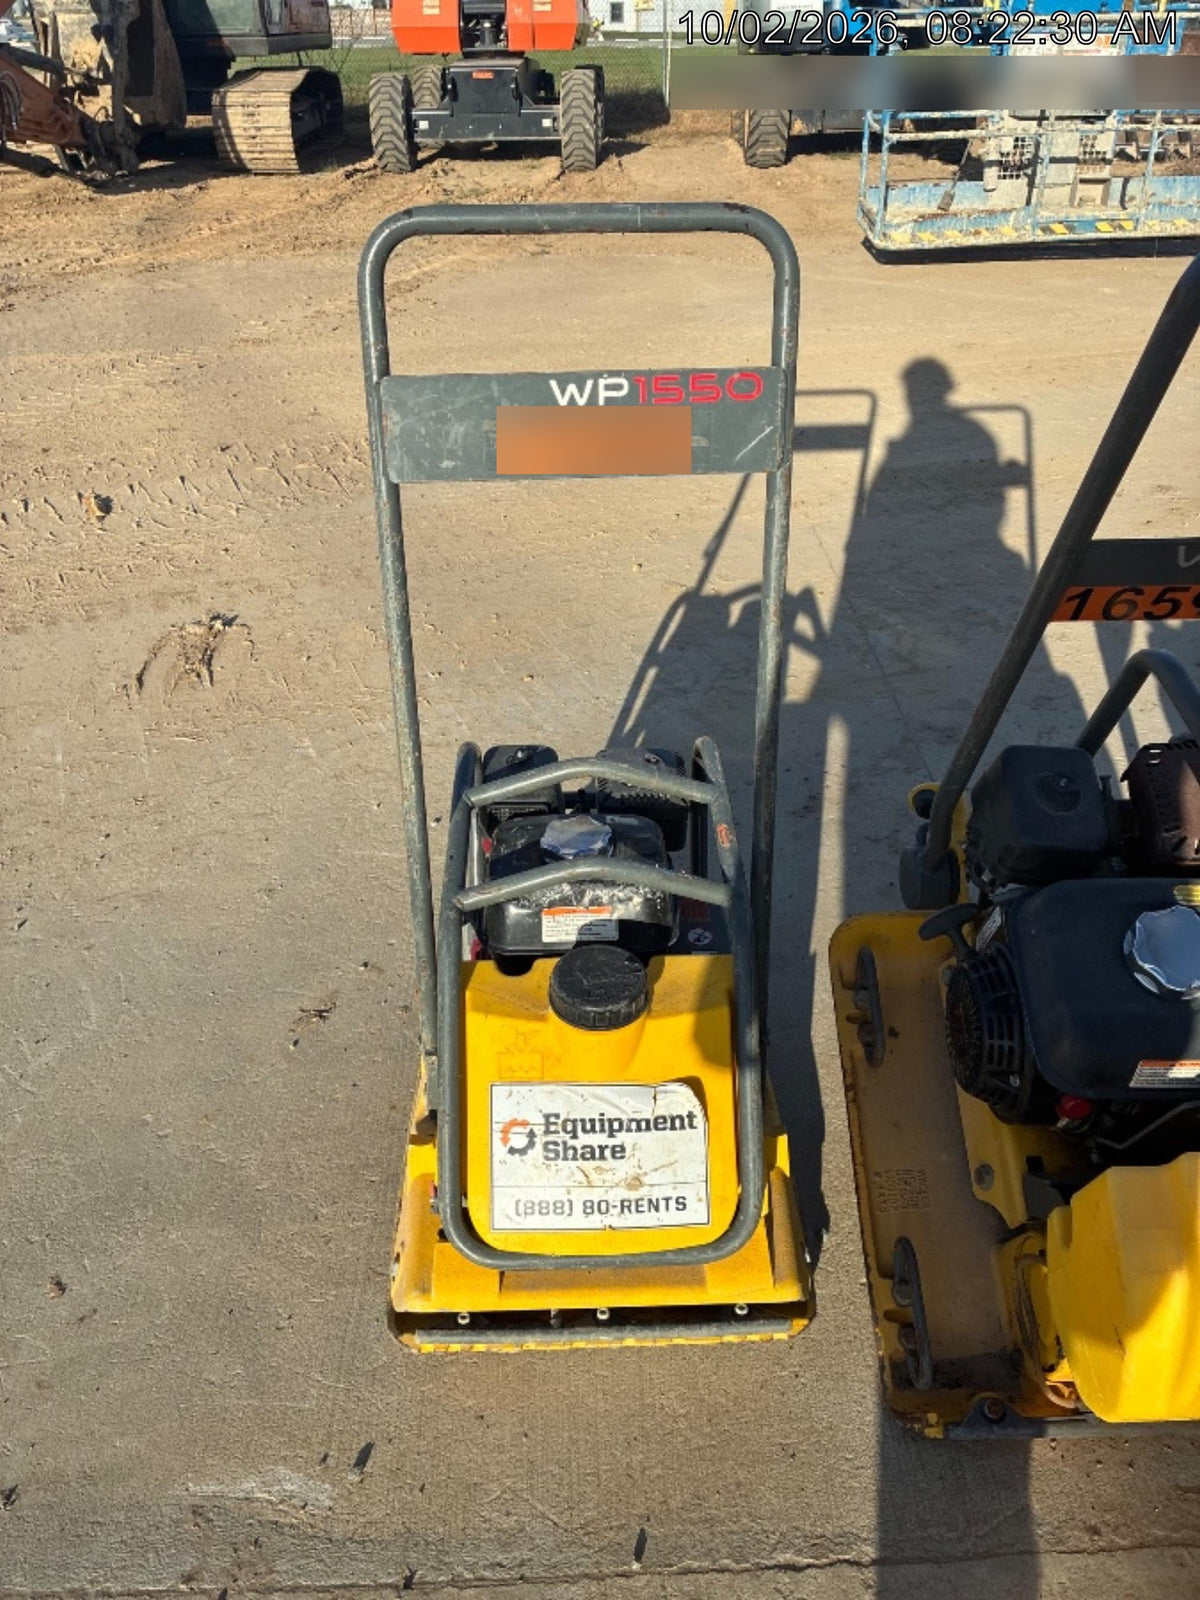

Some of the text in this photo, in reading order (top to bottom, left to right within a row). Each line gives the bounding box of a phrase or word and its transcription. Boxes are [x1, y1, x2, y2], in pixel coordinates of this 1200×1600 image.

[549, 371, 764, 407] WP1550
[1065, 586, 1200, 621] 165
[542, 1111, 698, 1139] Equipment
[543, 1140, 627, 1162] Share
[514, 1195, 688, 1217] (888) 80-RENTS
